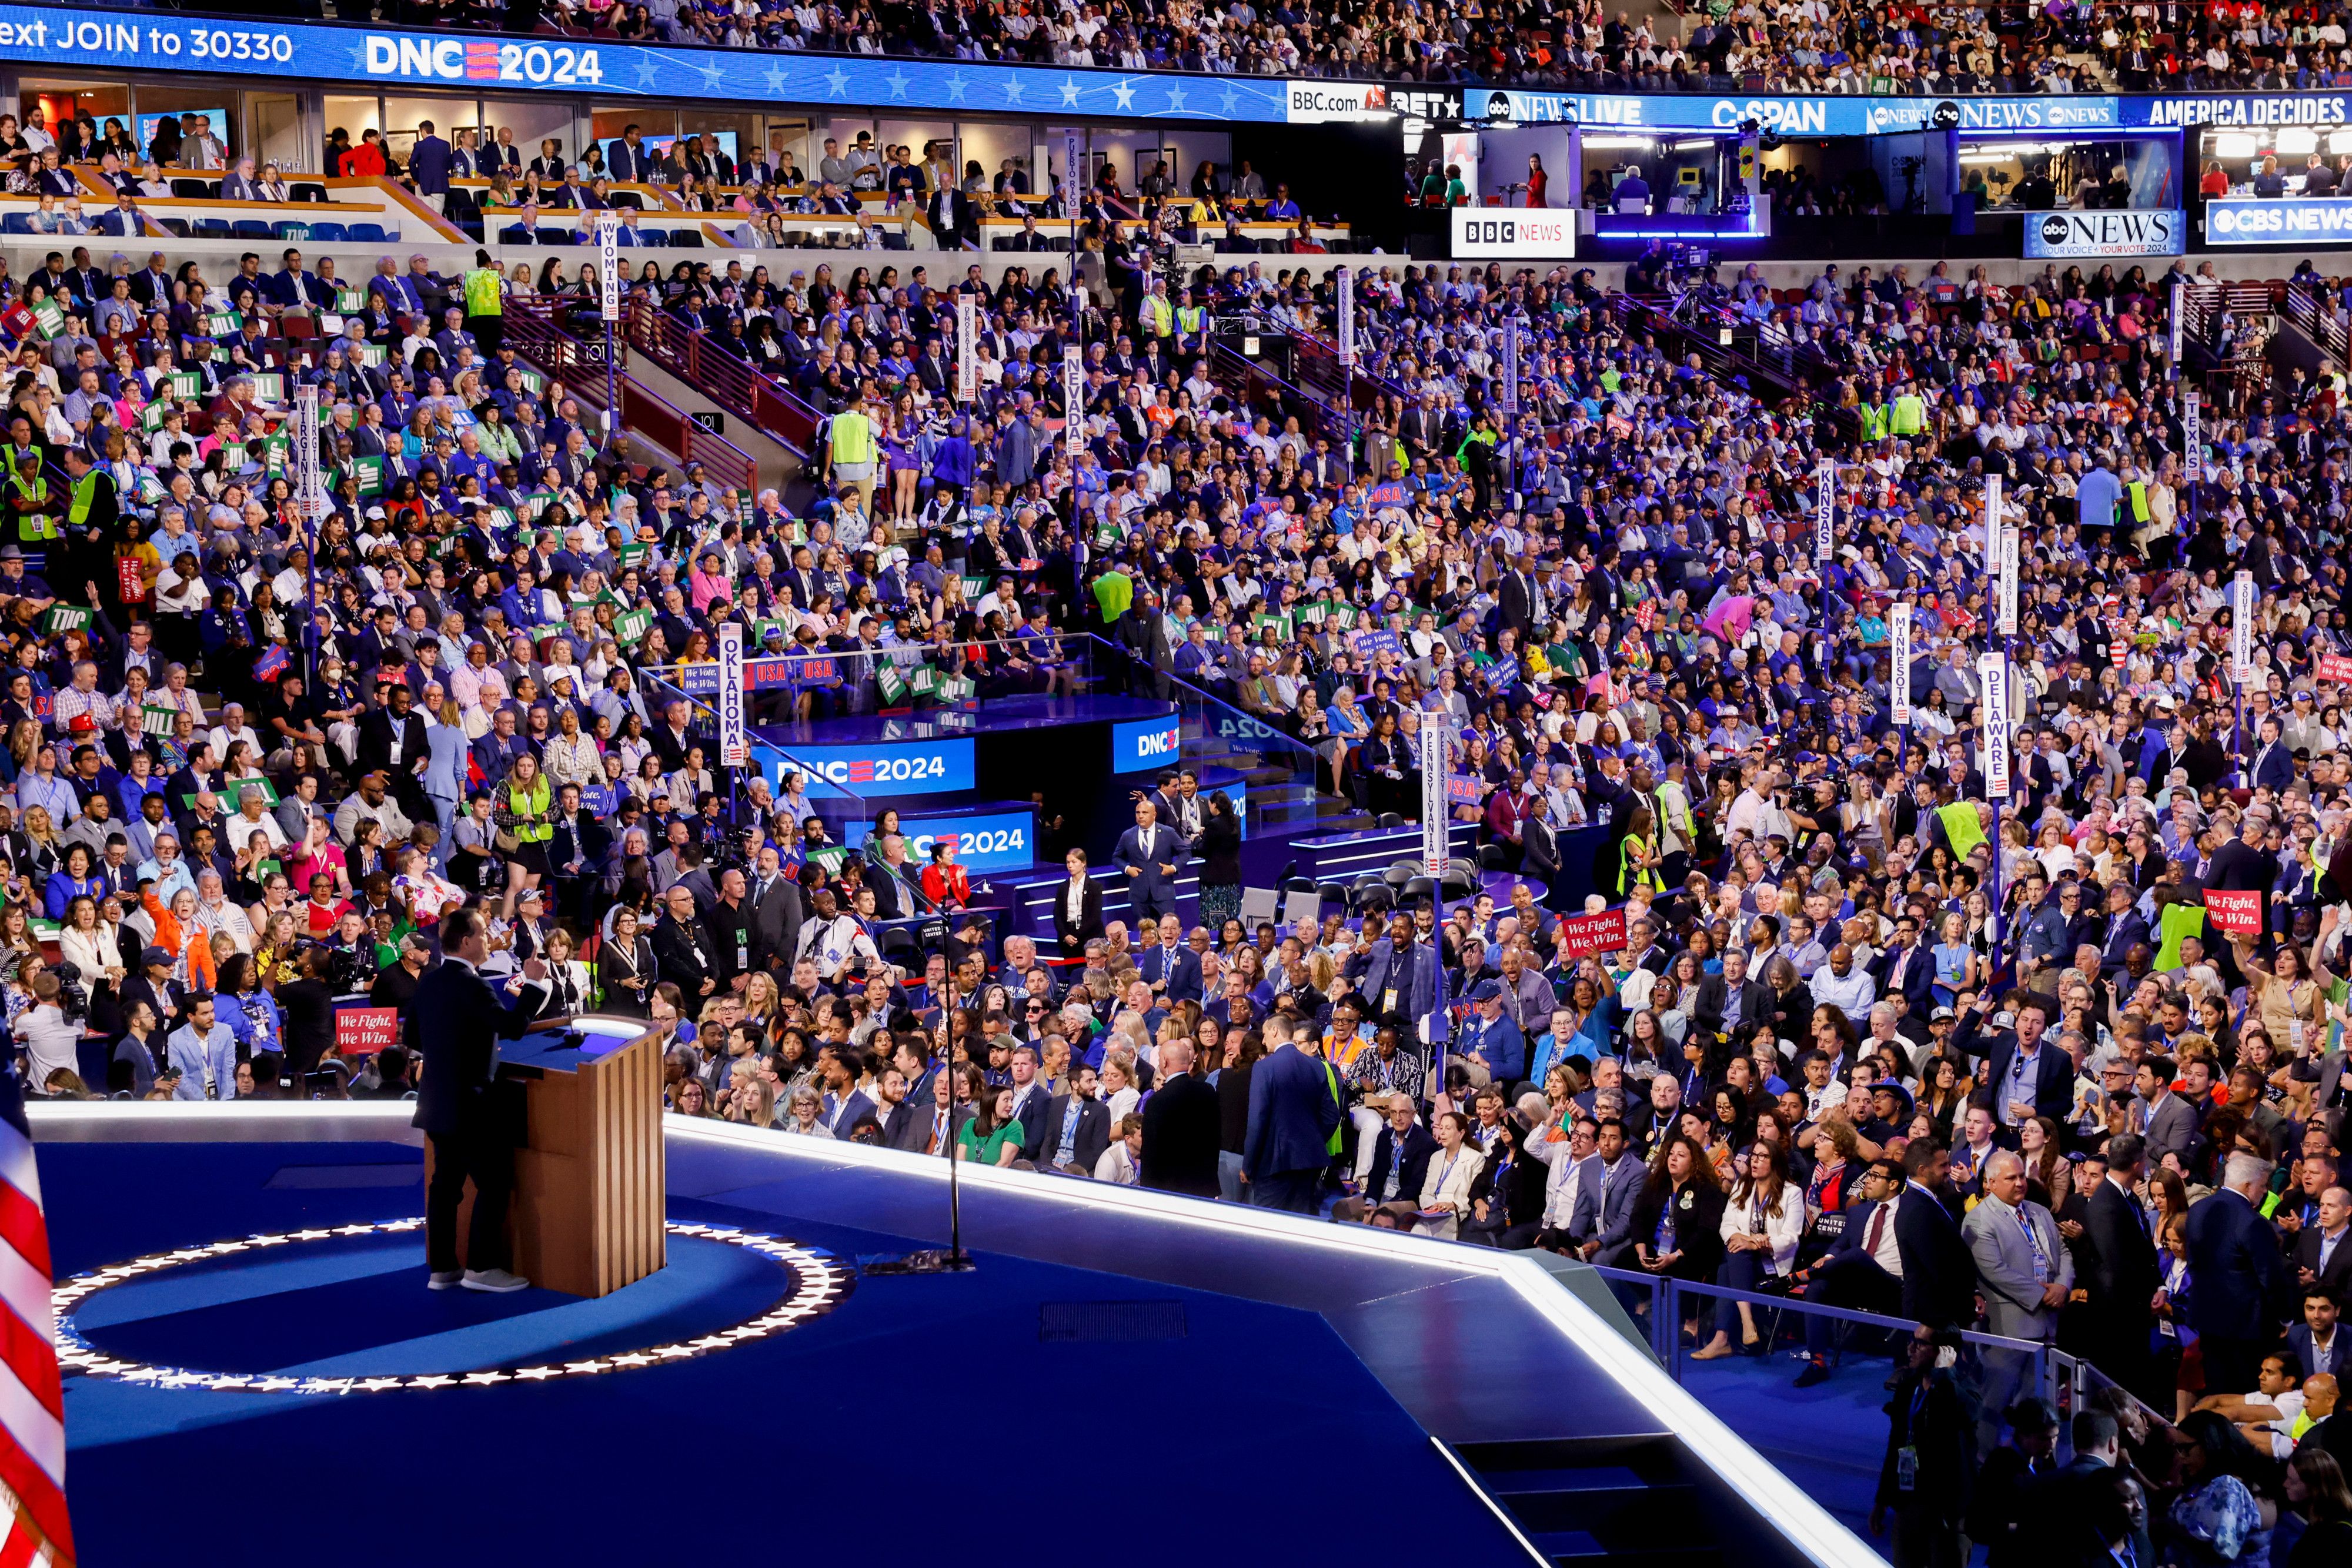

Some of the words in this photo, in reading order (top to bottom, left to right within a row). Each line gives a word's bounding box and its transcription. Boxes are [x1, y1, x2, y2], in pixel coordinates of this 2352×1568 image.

[0, 21, 47, 47] ext
[57, 21, 139, 52] JOIN
[148, 28, 181, 54] to
[190, 29, 292, 62] 30330
[366, 35, 463, 79] DNC
[500, 45, 603, 83] 2024
[1873, 79, 1887, 93] JILL
[1294, 92, 1358, 111] BBC.com
[1391, 92, 1444, 118] BET
[1489, 101, 1510, 115] abc
[1511, 96, 1578, 122] NEWS
[1581, 98, 1641, 125] LIVE
[1712, 101, 1825, 132] C-SPAN
[1887, 109, 1926, 124] NEWS
[1962, 103, 2041, 128] NEWS
[2064, 108, 2109, 123] NEWS
[2149, 98, 2247, 126] AMERICA
[2252, 97, 2346, 125] DECIDES
[2043, 222, 2068, 236] abc
[2070, 213, 2169, 244] NEWS
[2235, 208, 2281, 232] CBS
[1468, 223, 1513, 242] BBC
[1520, 224, 1562, 240] NEWS
[2042, 246, 2065, 254] YOUR
[2066, 246, 2092, 254] VOICE
[2100, 245, 2122, 253] YOUR
[2123, 245, 2145, 253] VOTE
[604, 223, 616, 304] WYOMING
[342, 292, 363, 311] JILL
[210, 315, 239, 336] JILL
[586, 345, 605, 361] 101
[1067, 359, 1081, 440] NEVADA
[701, 416, 714, 428] 101
[2187, 402, 2198, 468] TEXAS
[299, 400, 309, 498] VIRGINIA
[1372, 487, 1402, 503] USA
[1259, 502, 1279, 515] US
[1820, 470, 1831, 544] KANSAS
[489, 510, 513, 527] JILL
[122, 560, 129, 575] We
[131, 560, 139, 573] We
[131, 573, 141, 600] Fight,
[963, 580, 983, 598] JILL
[51, 608, 86, 630] JILL
[623, 614, 646, 641] JILL
[1360, 638, 1372, 647] We
[1374, 634, 1394, 644] Vote,
[804, 660, 833, 678] USA
[1488, 670, 1500, 681] We
[1500, 659, 1515, 673] Vote,
[1896, 617, 1905, 706] MINNESOTA
[2324, 658, 2334, 667] We
[2334, 660, 2352, 670] Figh
[686, 668, 698, 677] We
[699, 668, 717, 677] Vote,
[757, 664, 786, 682] USA
[913, 668, 934, 691] JILL
[2322, 667, 2334, 676] We
[686, 680, 698, 688] We
[699, 679, 717, 688] Win.
[724, 640, 739, 746] OKLAHOMA
[139, 710, 175, 737] JILL
[1987, 671, 2004, 775] DELAWARE
[1138, 731, 1168, 757] DNC
[777, 761, 848, 784] DNC
[875, 756, 945, 784] 2024
[960, 828, 1024, 855] 2024
[2207, 895, 2221, 908] We
[2221, 896, 2256, 911] Fight,
[1568, 924, 1586, 935] We
[1586, 917, 1620, 933] Fight,
[2210, 910, 2224, 923] We
[2226, 912, 2257, 925] Win.
[923, 926, 941, 935] UNITED
[1571, 937, 1590, 950] We
[1593, 932, 1622, 947] Win.
[340, 1016, 357, 1028] We
[358, 1014, 392, 1029] Fight,
[340, 1032, 358, 1045] We
[361, 1031, 391, 1044] Win.
[1817, 1224, 1843, 1234] CENTE
